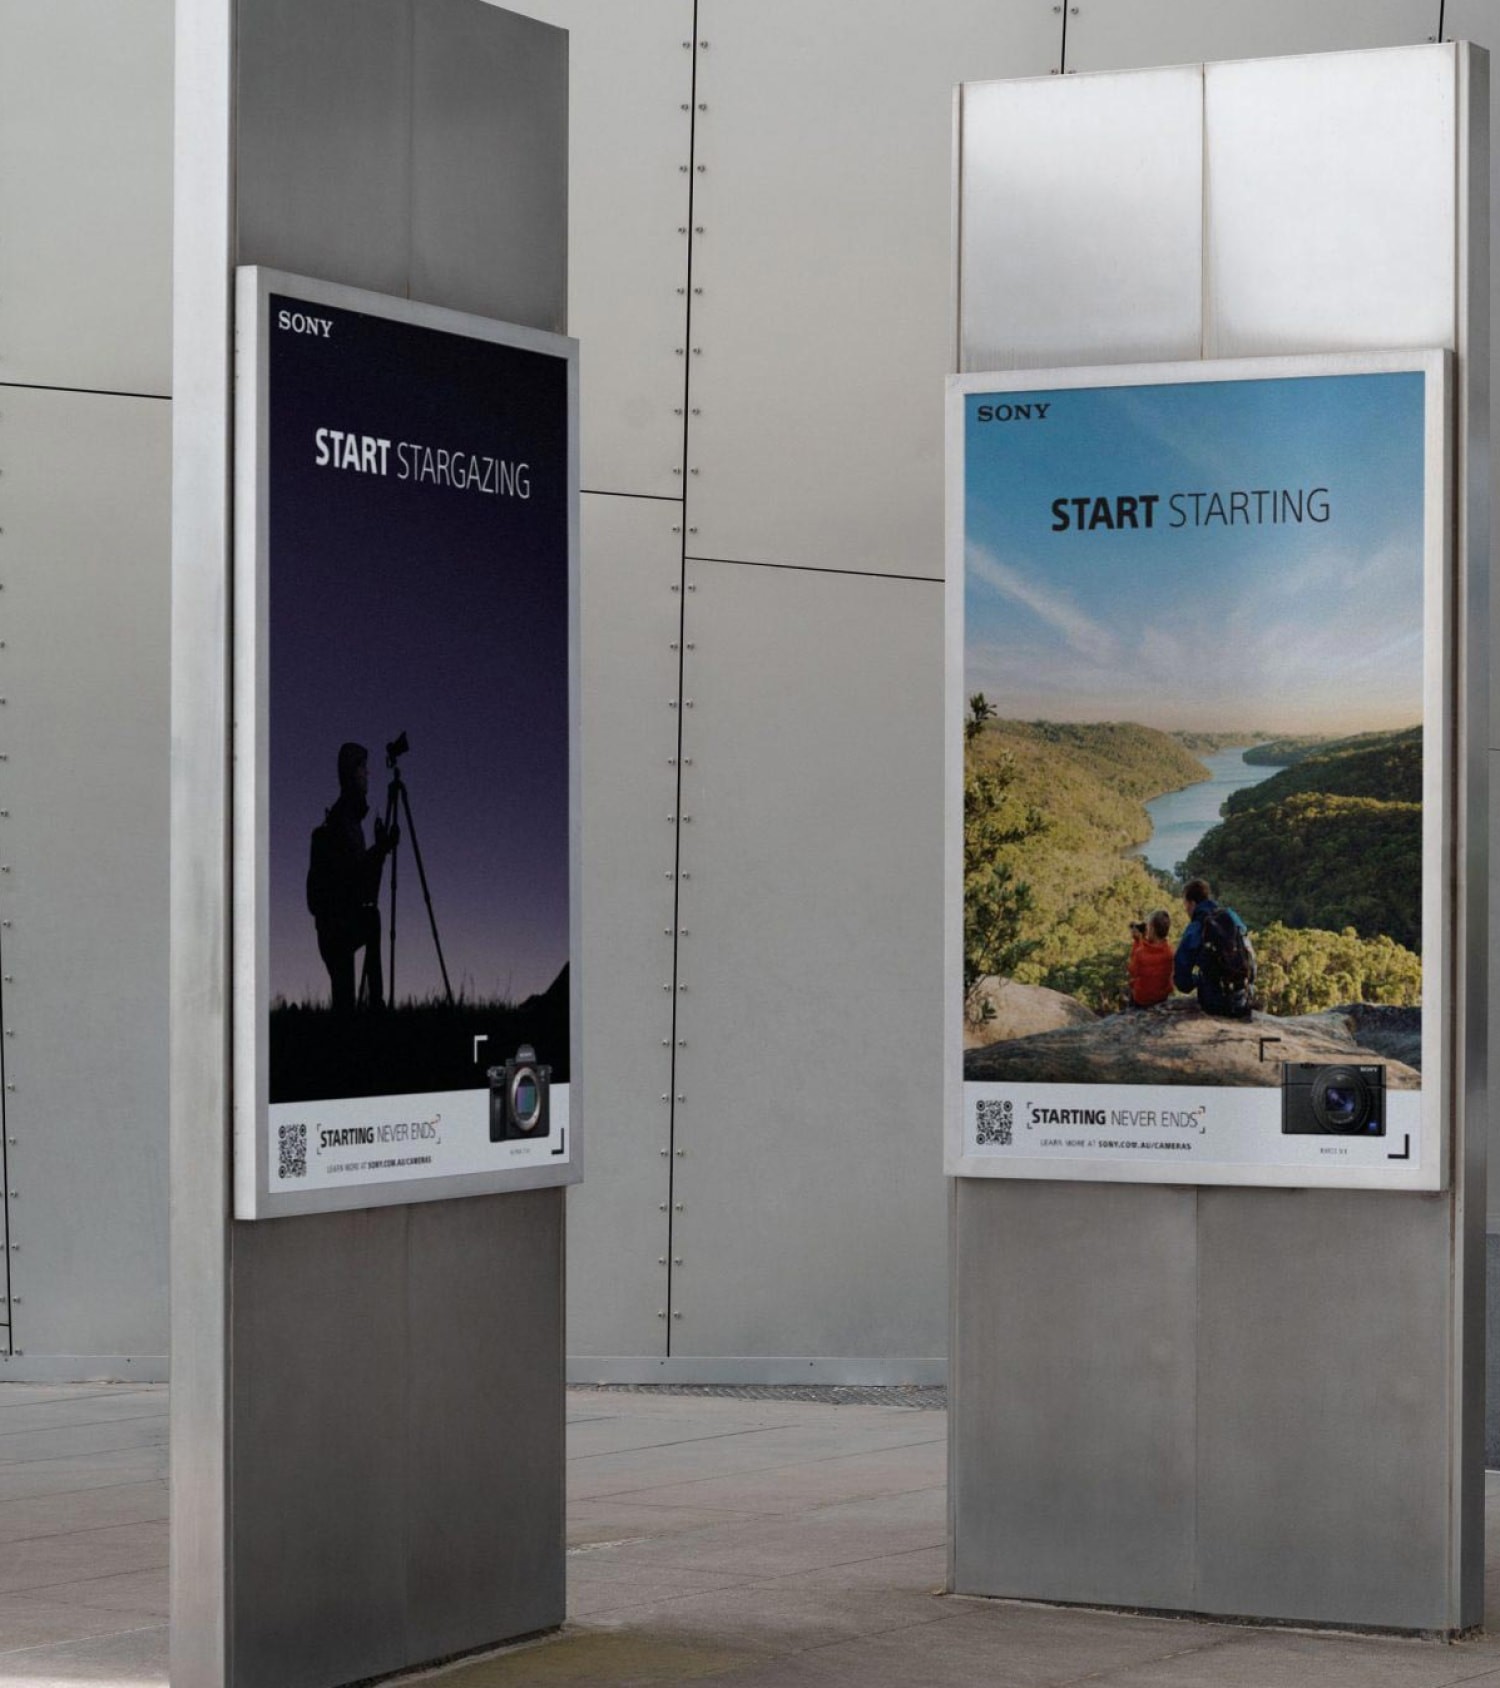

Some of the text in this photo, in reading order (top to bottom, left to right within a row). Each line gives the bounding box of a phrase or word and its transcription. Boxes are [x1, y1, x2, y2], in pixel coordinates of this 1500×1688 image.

[278, 310, 333, 338] SONY
[977, 403, 1052, 422] SONY
[315, 427, 530, 499] START STARGAZING
[1052, 488, 1330, 531] START STARTING
[1032, 1108, 1198, 1128] STARTING NEVER ENDS
[320, 1121, 436, 1148] STARTING NEVER ENDS
[1040, 1139, 1063, 1147] LEARN
[1066, 1139, 1085, 1148] MORE
[1098, 1140, 1192, 1150] SONY.COM.AU/CAMERAS
